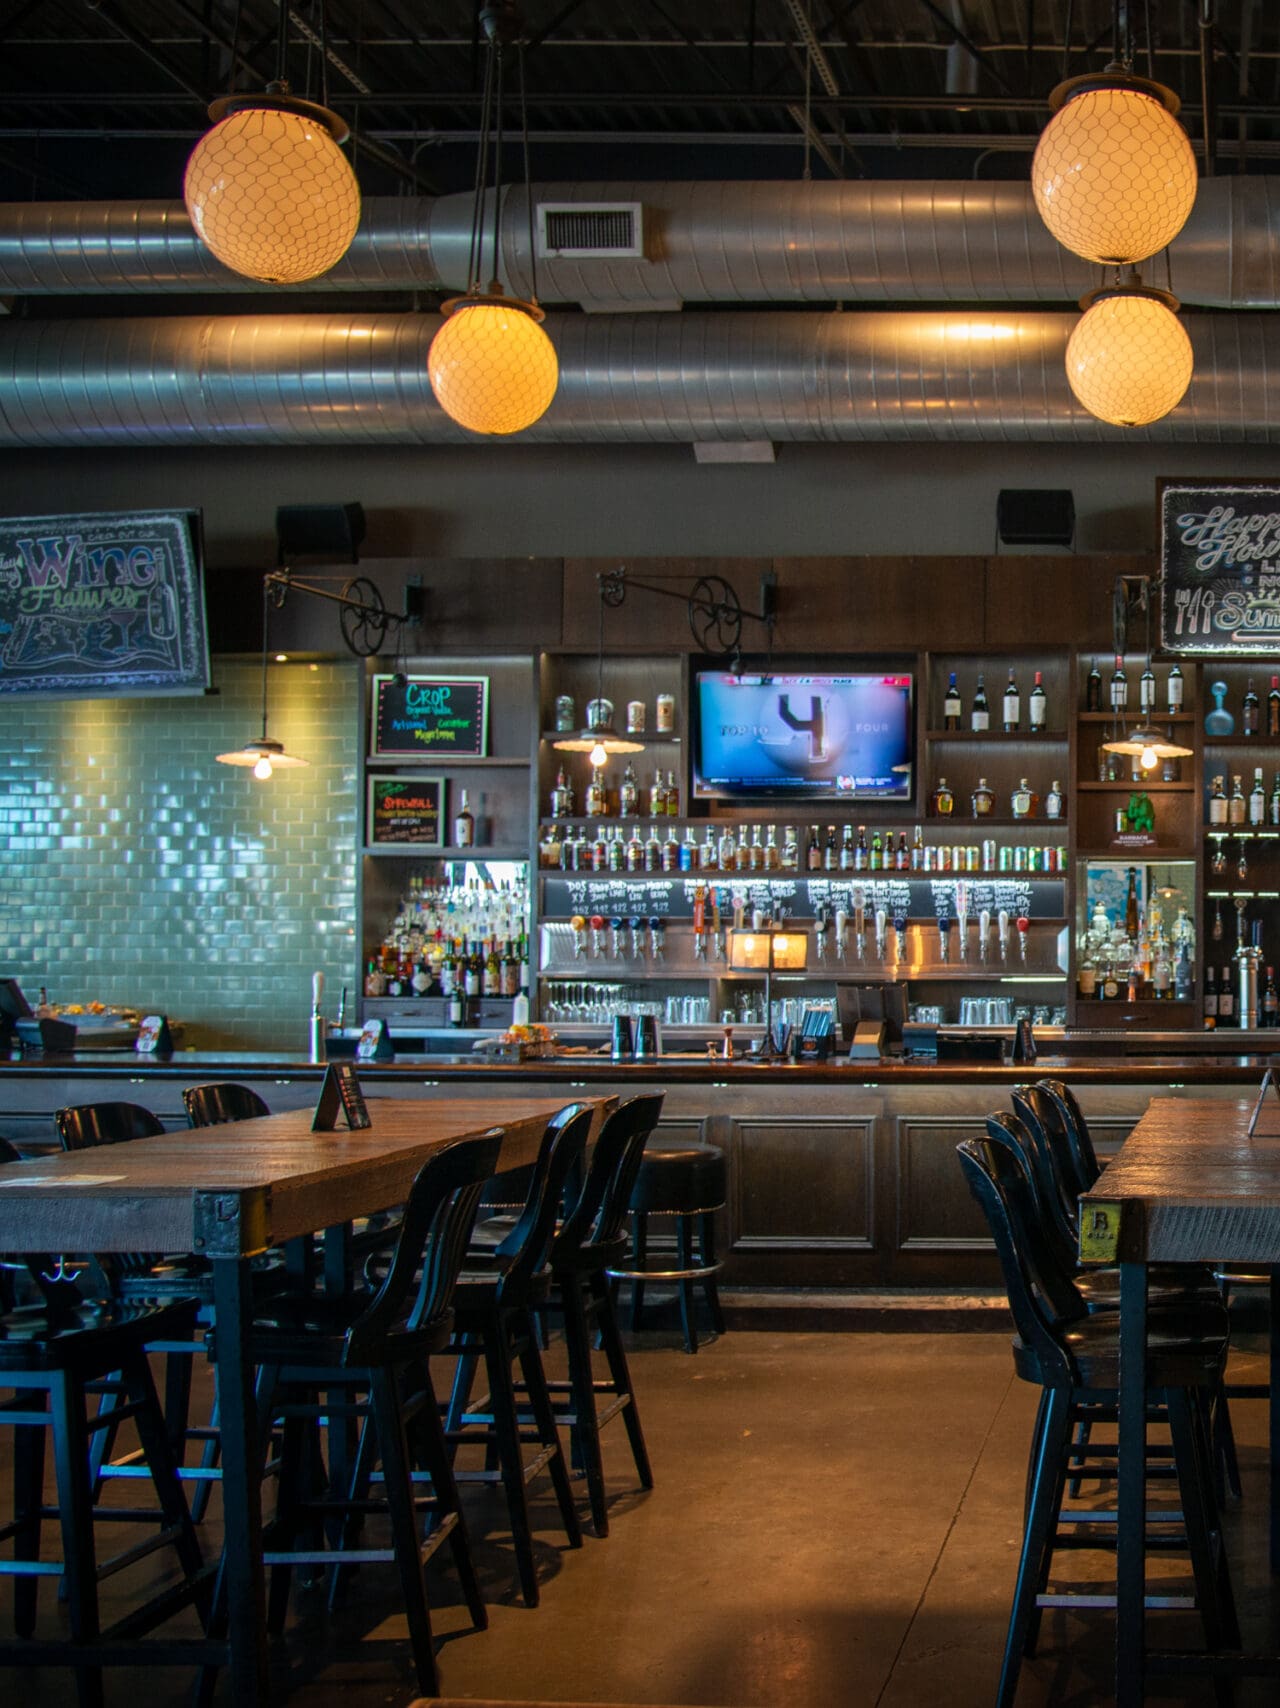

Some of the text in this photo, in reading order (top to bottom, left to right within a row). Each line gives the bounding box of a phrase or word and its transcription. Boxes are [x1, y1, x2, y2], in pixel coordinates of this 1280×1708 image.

[15, 534, 156, 589] Wine
[778, 693, 829, 763] 4
[855, 722, 890, 733] FOUR
